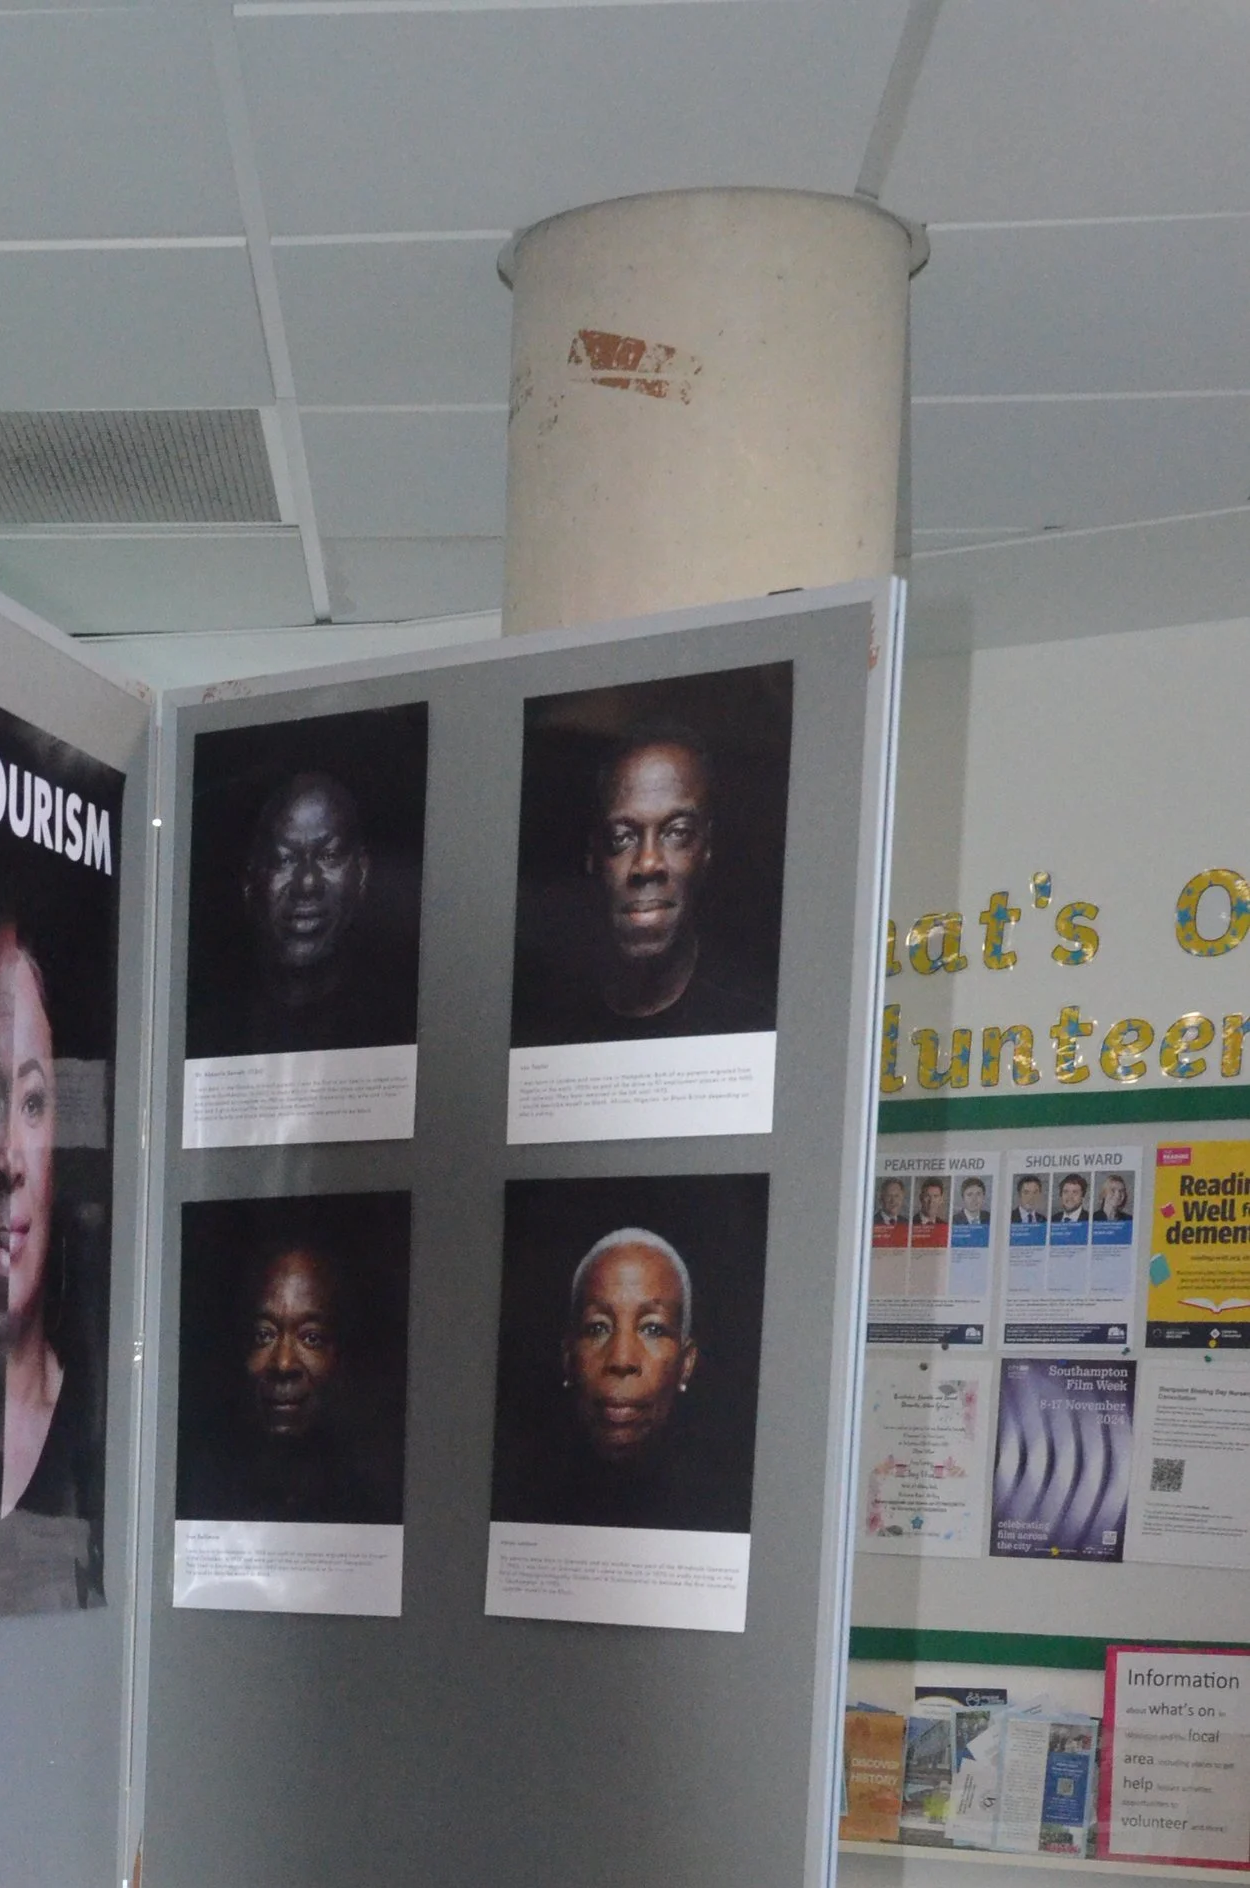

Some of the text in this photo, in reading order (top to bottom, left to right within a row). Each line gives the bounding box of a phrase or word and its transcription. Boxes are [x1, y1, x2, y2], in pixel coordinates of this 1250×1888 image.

[884, 1157, 985, 1171] PEARTREE WARD
[1025, 1153, 1123, 1168] SHOLING WARD
[1183, 1199, 1236, 1222] Well
[1049, 1365, 1128, 1378] Southampton
[1066, 1379, 1128, 1392] Film Week
[1068, 1400, 1126, 1412] November
[1096, 1413, 1126, 1425] 2024
[997, 1519, 1050, 1532] celebrating
[997, 1530, 1049, 1542] film across
[1128, 1668, 1240, 1689] Information
[1148, 1702, 1215, 1717] what's on
[1188, 1728, 1220, 1743] local
[850, 1757, 900, 1770] DISCOVER
[1124, 1754, 1154, 1765] area
[850, 1773, 899, 1786] HISTORY
[1123, 1776, 1153, 1793] help
[1121, 1814, 1188, 1831] volunteer
